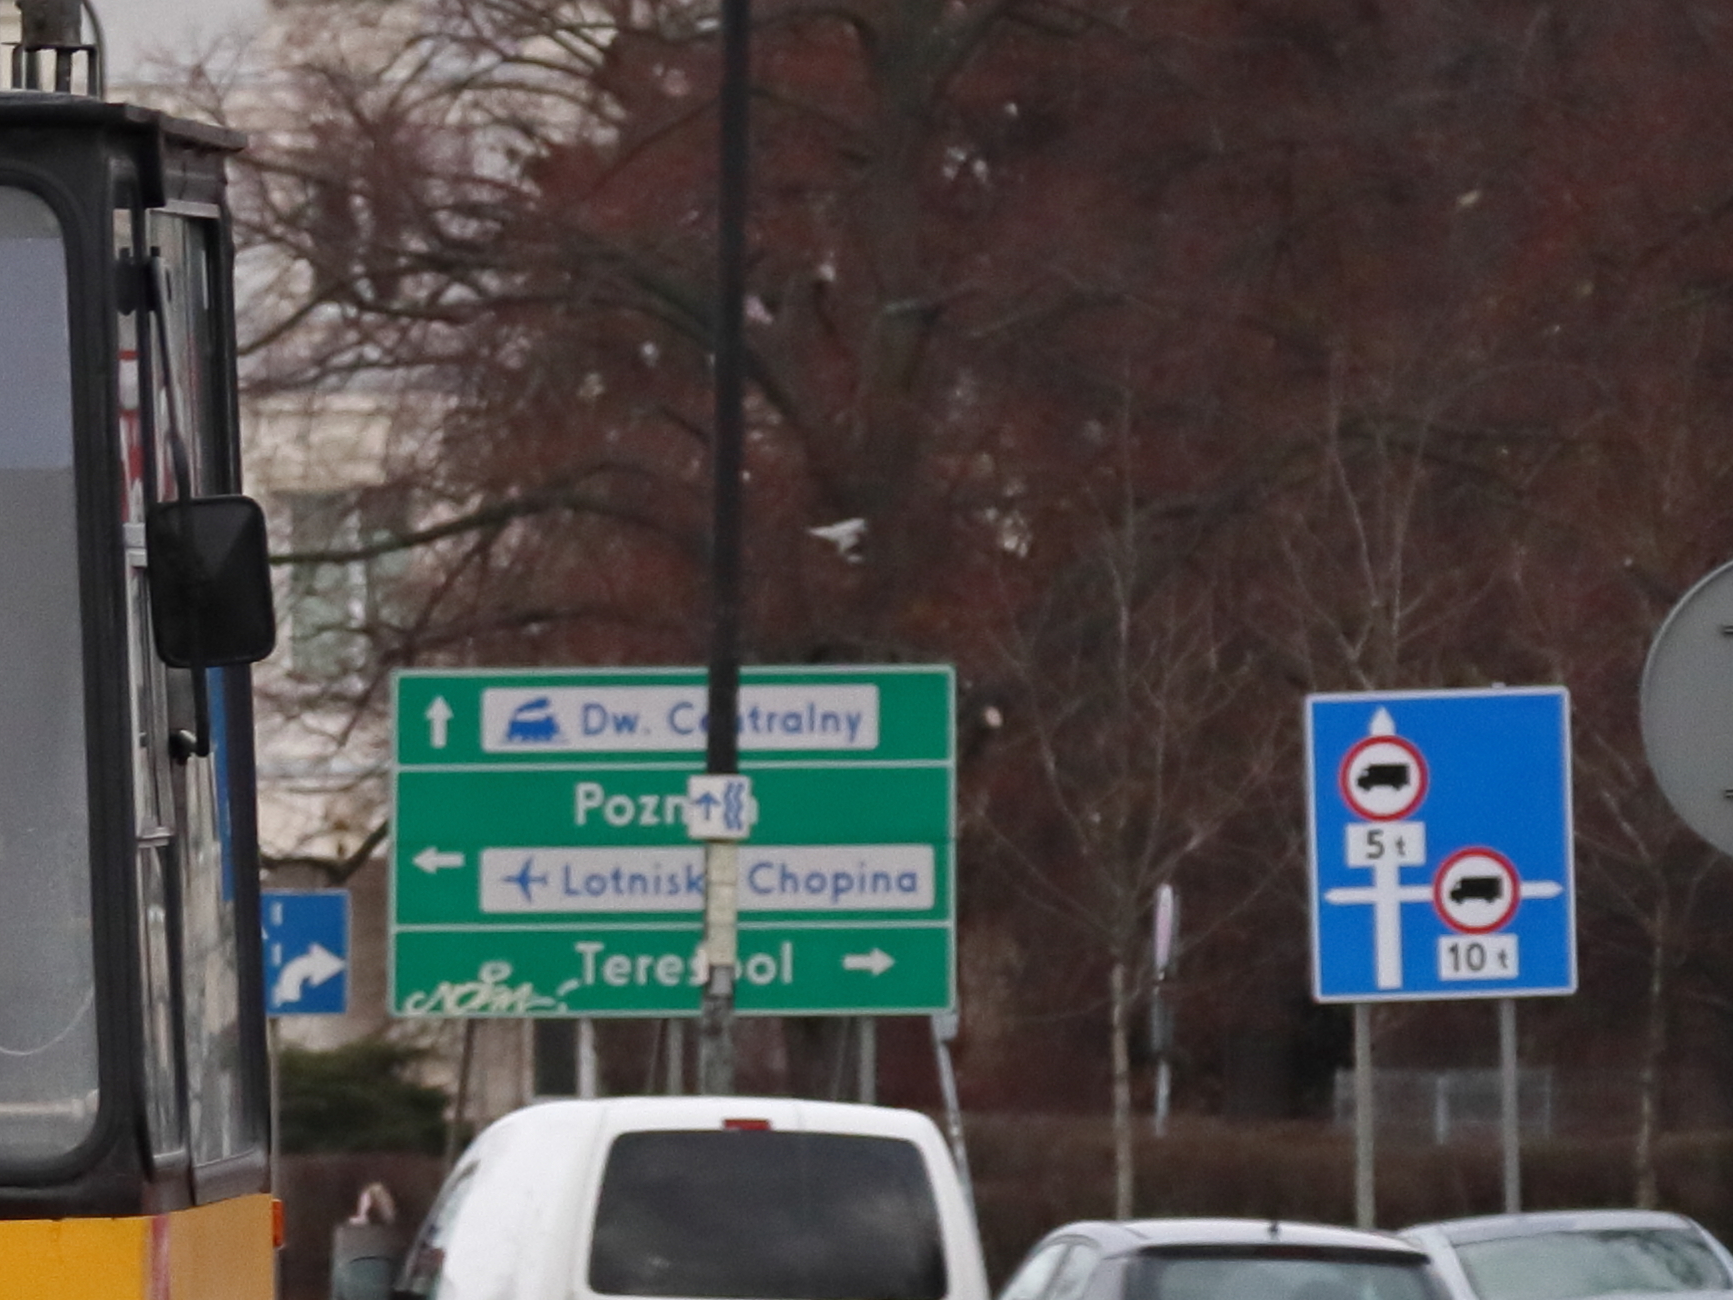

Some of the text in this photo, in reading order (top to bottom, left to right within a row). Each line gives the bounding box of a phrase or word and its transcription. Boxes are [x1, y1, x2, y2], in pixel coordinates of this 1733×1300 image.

[582, 701, 860, 743] Dw. Ctralny
[574, 782, 759, 826] Pozn
[1366, 829, 1384, 859] 5
[564, 862, 918, 903] Lotnisk Chopina
[574, 941, 793, 986] Teresol
[1449, 943, 1485, 972] 10
